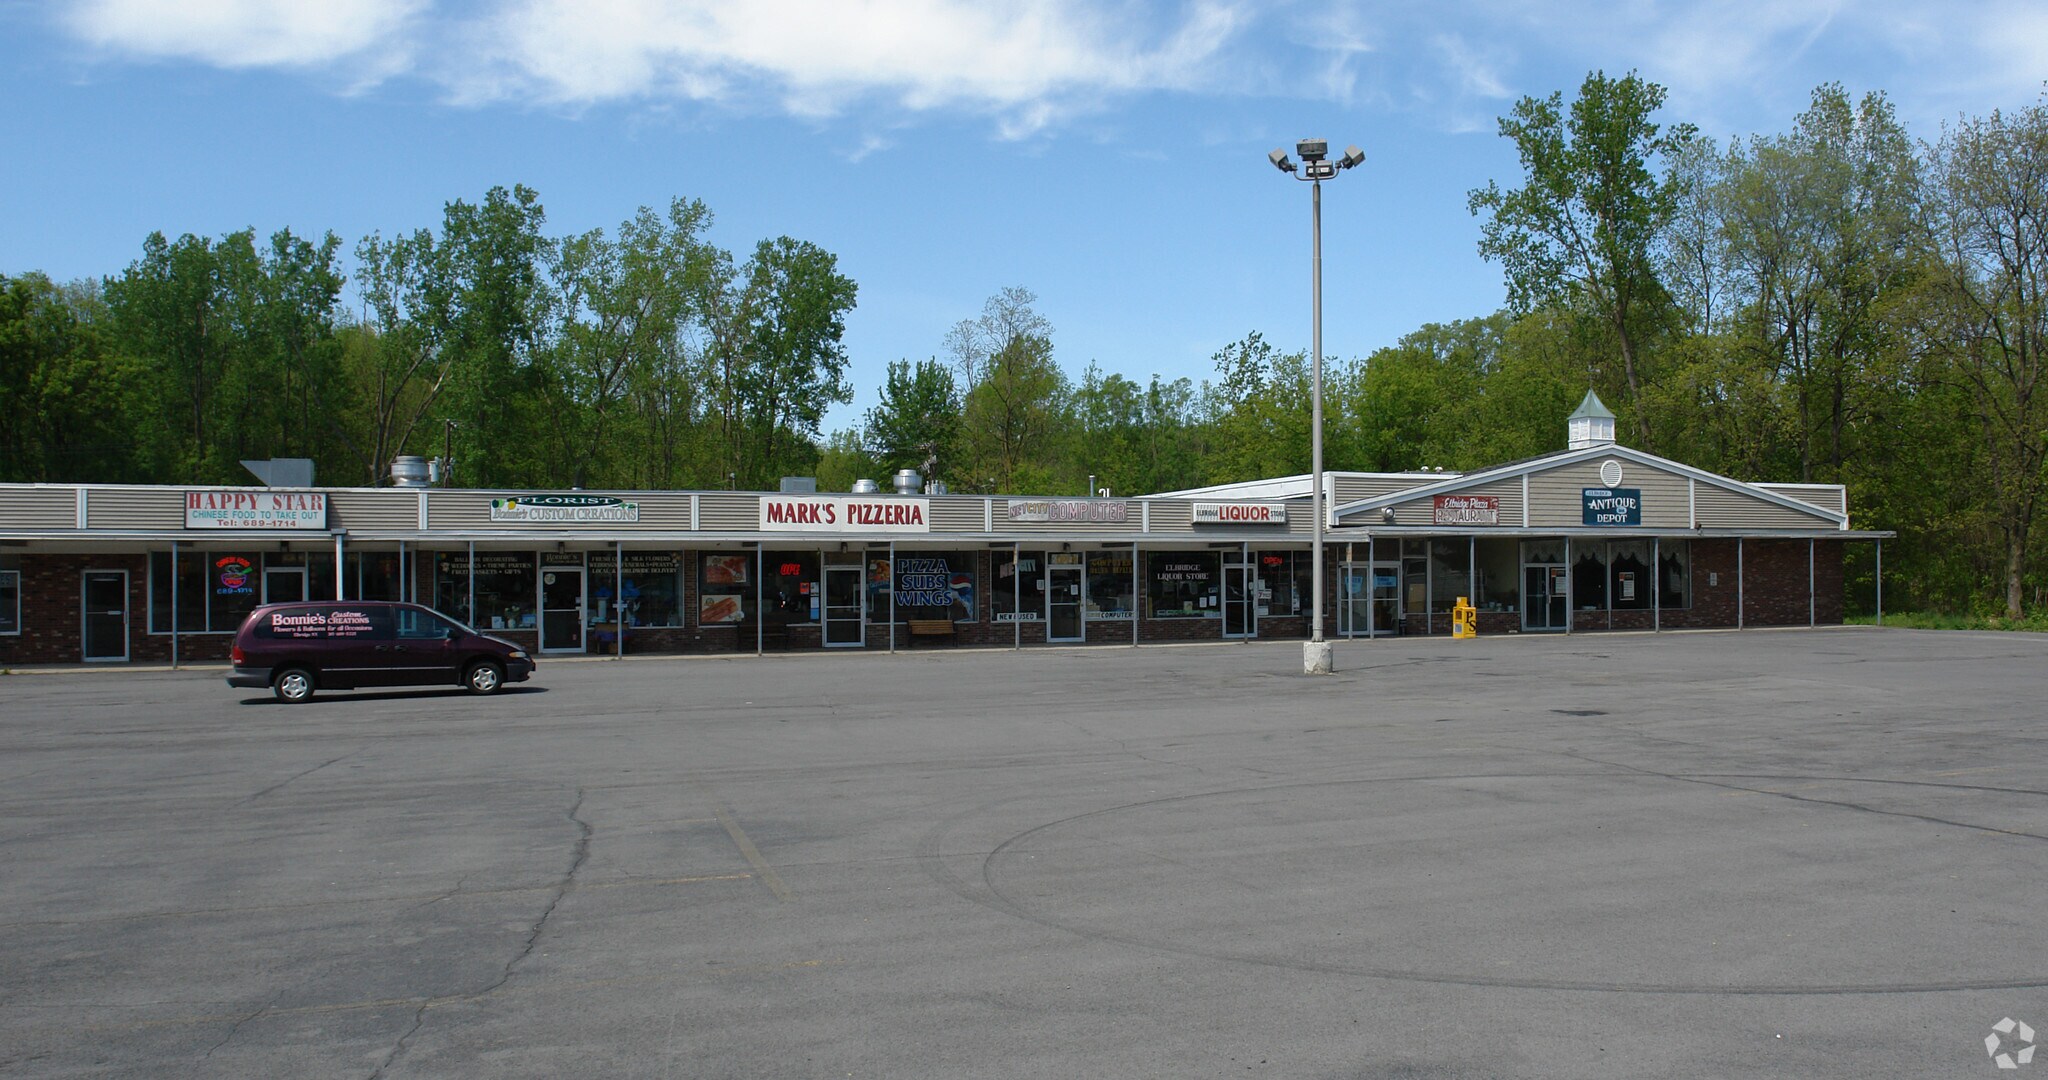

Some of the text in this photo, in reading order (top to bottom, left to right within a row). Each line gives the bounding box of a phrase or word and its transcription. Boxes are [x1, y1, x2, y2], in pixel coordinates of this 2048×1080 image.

[187, 493, 323, 510] HAPPY STAR
[1444, 498, 1488, 510] Elbridge Plaza
[1588, 496, 1636, 510] ANTIQUE
[492, 508, 637, 520] Bonnie's CUSTOM CREATIONS
[766, 502, 924, 525] MARK'S PIZZERIA
[1049, 502, 1126, 520] COMPUTER
[1219, 506, 1270, 520] LIQUOR
[1597, 514, 1628, 522] DEPOT
[896, 558, 951, 574] PIZZA
[1263, 556, 1282, 564] OPEN
[902, 574, 946, 590] SUBS
[894, 590, 954, 606] WINGS
[272, 613, 326, 626] Bonnie's
[1466, 611, 1473, 623] P
[1469, 620, 1476, 632] S
